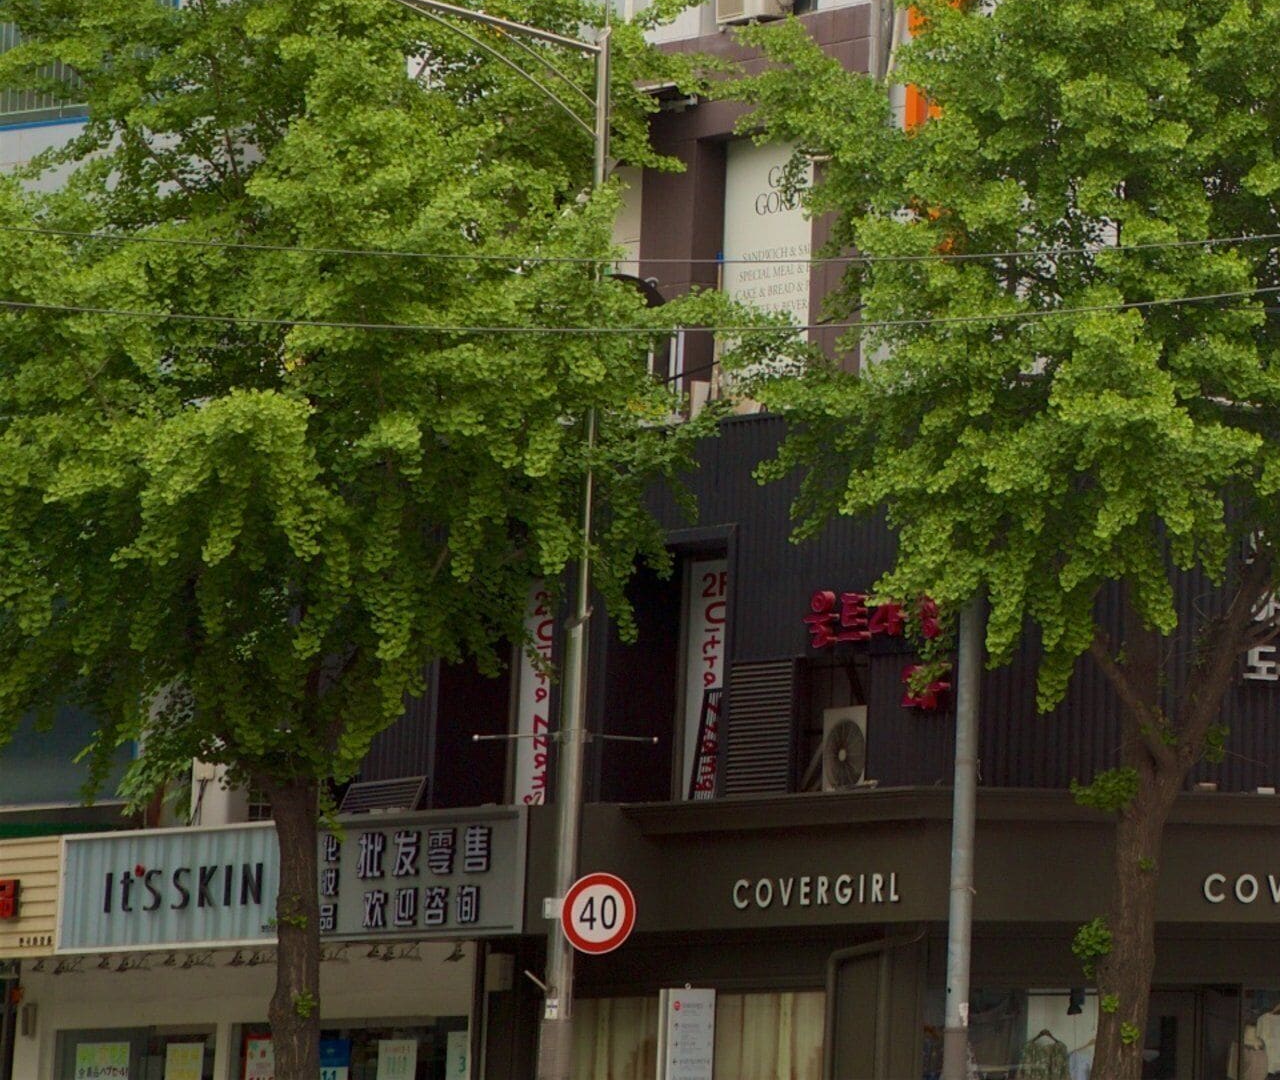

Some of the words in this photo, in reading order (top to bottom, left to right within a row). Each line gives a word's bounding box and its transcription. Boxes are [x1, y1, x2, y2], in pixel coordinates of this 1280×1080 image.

[358, 826, 489, 878] 批发零售
[171, 862, 264, 910] SKIN
[363, 885, 478, 928] 欢迎咨询
[732, 872, 899, 909] COVERGIRL
[579, 896, 618, 931] 40
